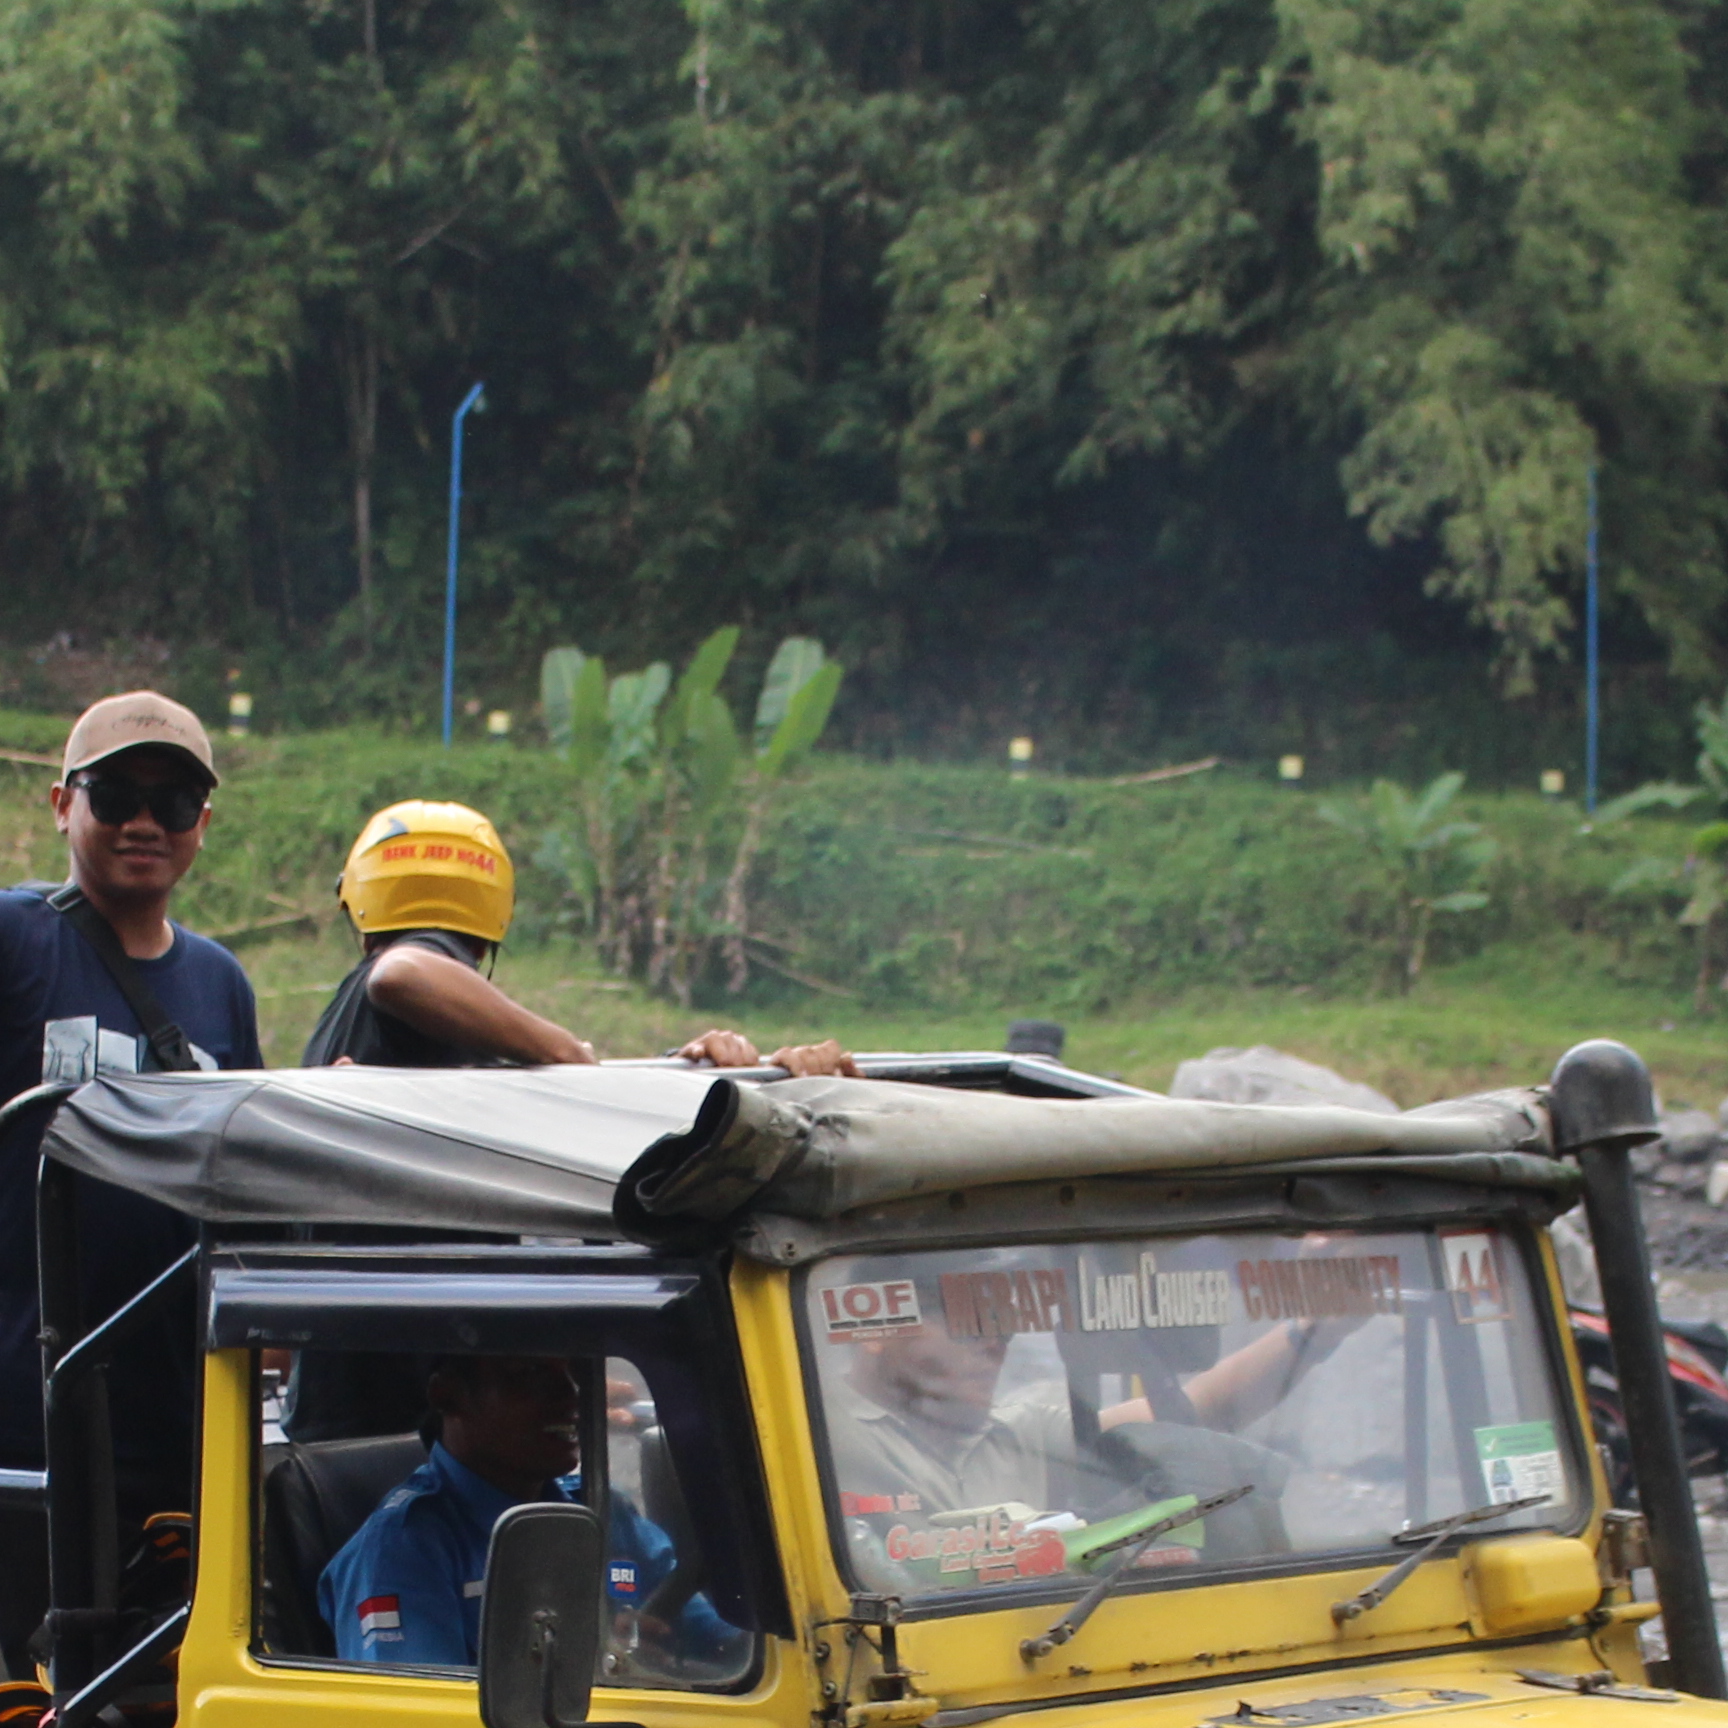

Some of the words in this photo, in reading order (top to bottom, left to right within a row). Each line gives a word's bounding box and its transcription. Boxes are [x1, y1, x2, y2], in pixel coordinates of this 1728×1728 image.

[422, 845, 453, 860] JEEP
[822, 1282, 914, 1322] IOF
[610, 1567, 635, 1584] BRI
